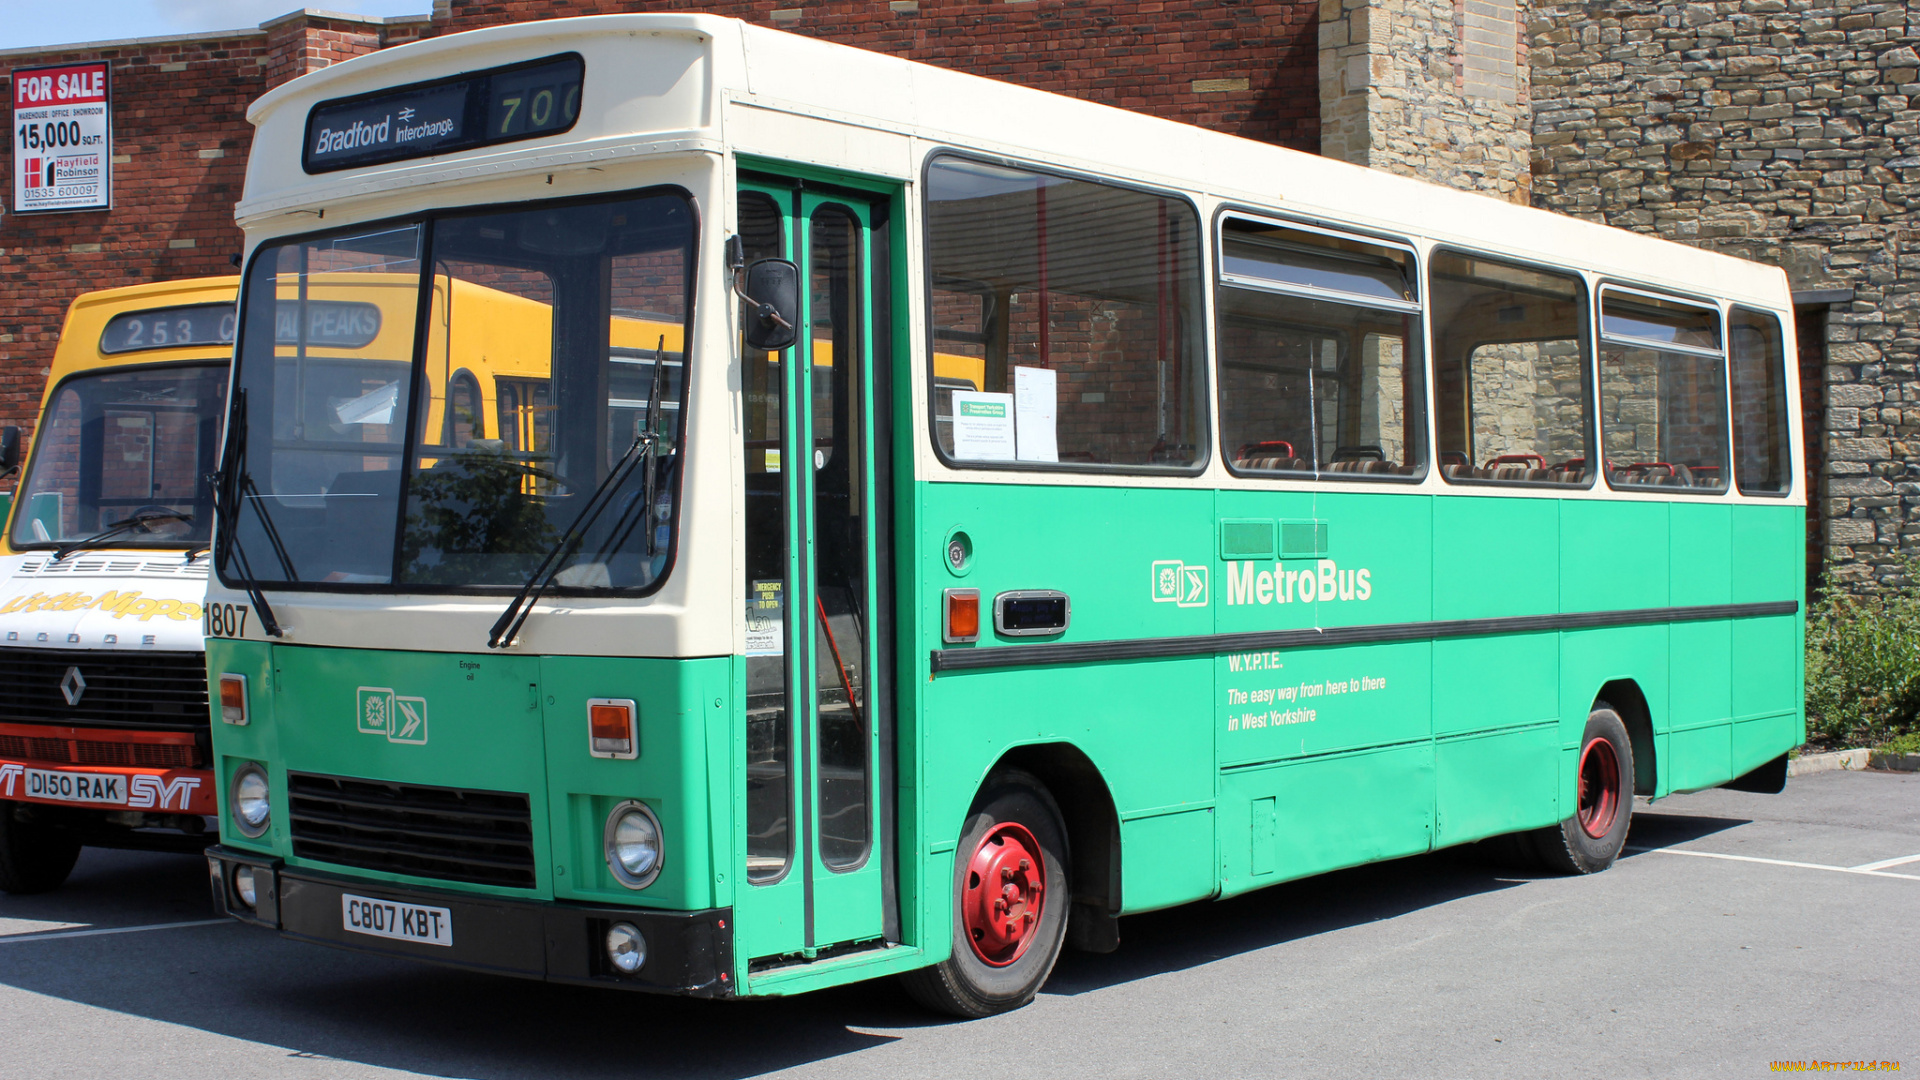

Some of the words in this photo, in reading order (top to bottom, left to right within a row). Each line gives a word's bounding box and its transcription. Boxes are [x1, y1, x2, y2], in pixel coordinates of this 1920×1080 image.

[18, 76, 52, 102] FOR
[57, 71, 104, 99] SALE
[18, 110, 48, 120] WAREHOUSE
[52, 109, 69, 118] OFFICE
[73, 107, 103, 116] SHOWROOM
[19, 121, 80, 154] 15,000
[82, 135, 103, 145] SQ.FT.
[316, 115, 390, 154] Bradford
[396, 118, 454, 143] Interchange
[57, 156, 99, 169] Hayfield
[57, 167, 99, 177] Robinson
[24, 188, 54, 198] 01535
[59, 186, 98, 196] 600097
[24, 198, 97, 207] www.hayfieldrobinson.co.uk
[310, 309, 377, 337] PEAKS
[1226, 559, 1372, 606] MetroBus
[0, 591, 92, 614] Little
[203, 602, 249, 638] 1807
[459, 661, 481, 670] Engine
[1228, 651, 1283, 672] W.Y.P.T.E.
[466, 673, 474, 681] oil
[1228, 688, 1248, 705] The
[1250, 687, 1275, 706] easy
[1277, 684, 1298, 702] way
[1299, 682, 1323, 698] from
[1326, 679, 1347, 695] here
[1349, 678, 1360, 692] to
[1361, 675, 1386, 691] there
[1228, 715, 1239, 731] in
[1241, 713, 1268, 729] West
[1269, 706, 1316, 727] Yorkshire
[77, 777, 119, 800] RAK
[128, 774, 201, 810] SYT
[350, 900, 396, 933] C807
[402, 907, 442, 939] KBT
